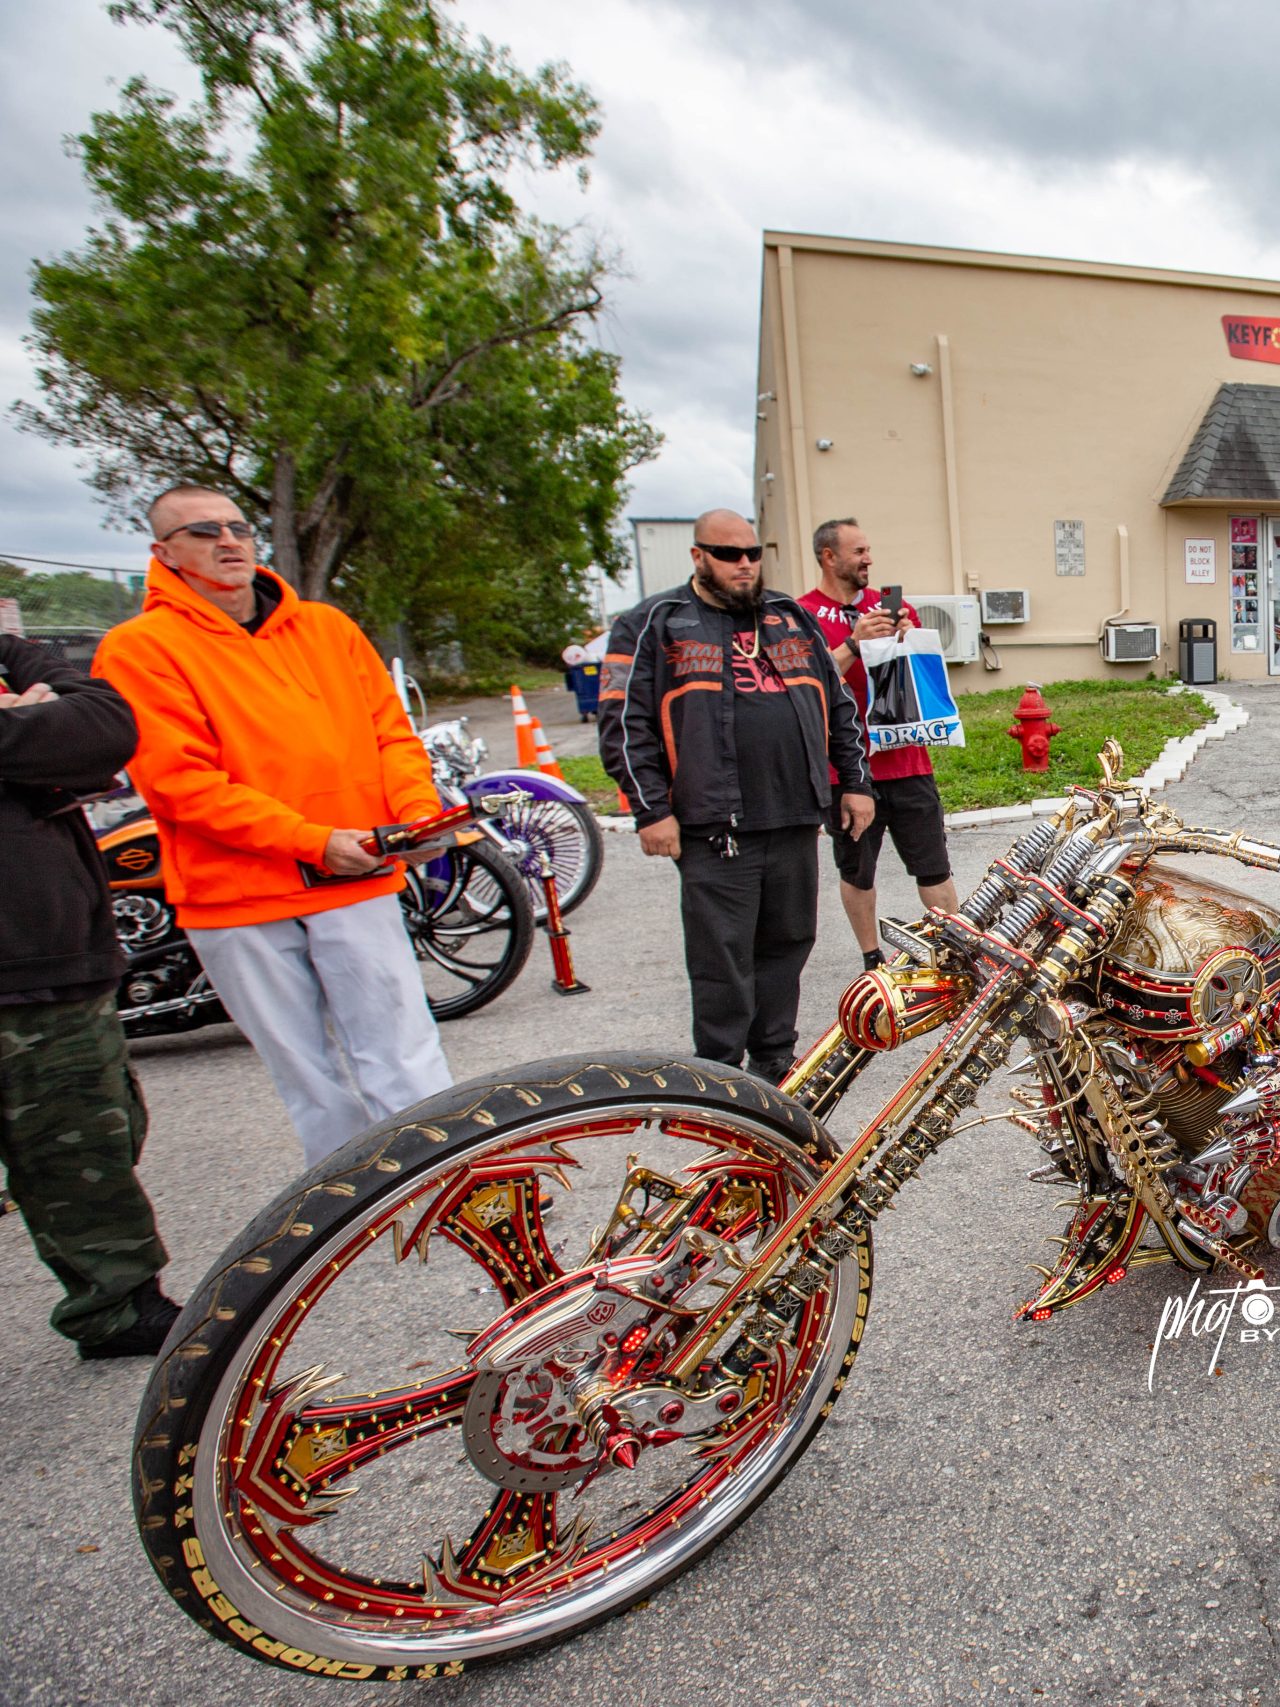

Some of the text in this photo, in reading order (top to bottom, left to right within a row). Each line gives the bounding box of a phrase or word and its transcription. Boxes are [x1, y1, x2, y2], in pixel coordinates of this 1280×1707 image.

[1188, 545, 1212, 553] DO NOT
[1190, 557, 1210, 565] BLOCK
[1191, 569, 1210, 577] ALLEY
[877, 720, 949, 746] DRAG
[851, 1230, 870, 1342] ADASS
[182, 1537, 377, 1680] CHOPPERS
